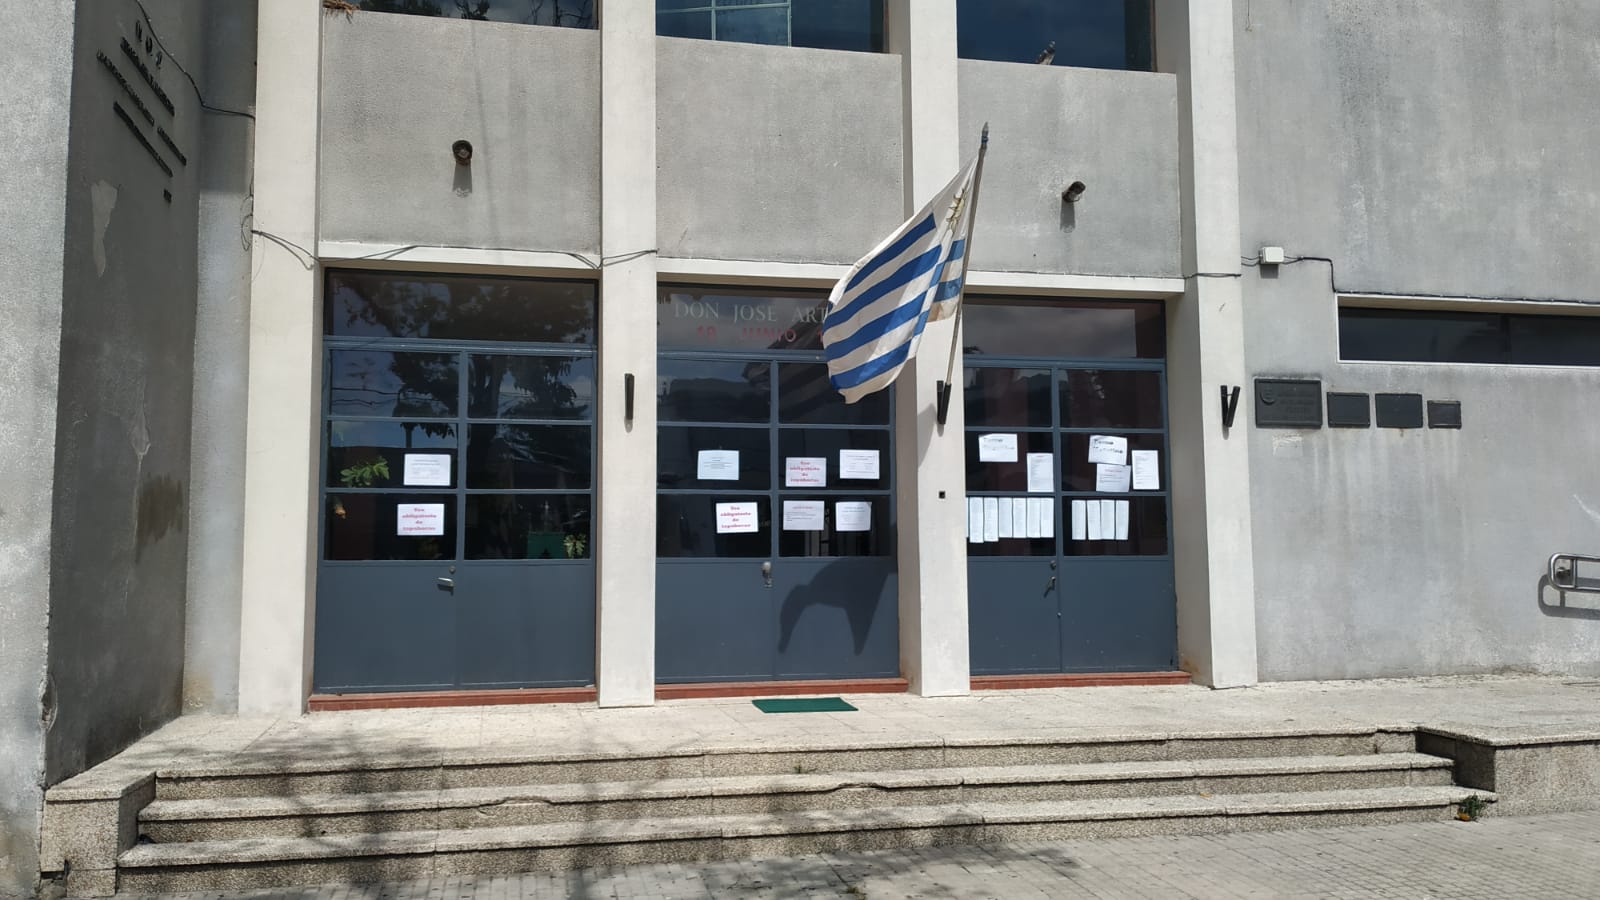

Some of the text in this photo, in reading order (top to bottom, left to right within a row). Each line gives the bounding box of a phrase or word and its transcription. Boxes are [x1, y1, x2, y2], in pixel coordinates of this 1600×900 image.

[674, 302, 829, 323] DON JOSE ART
